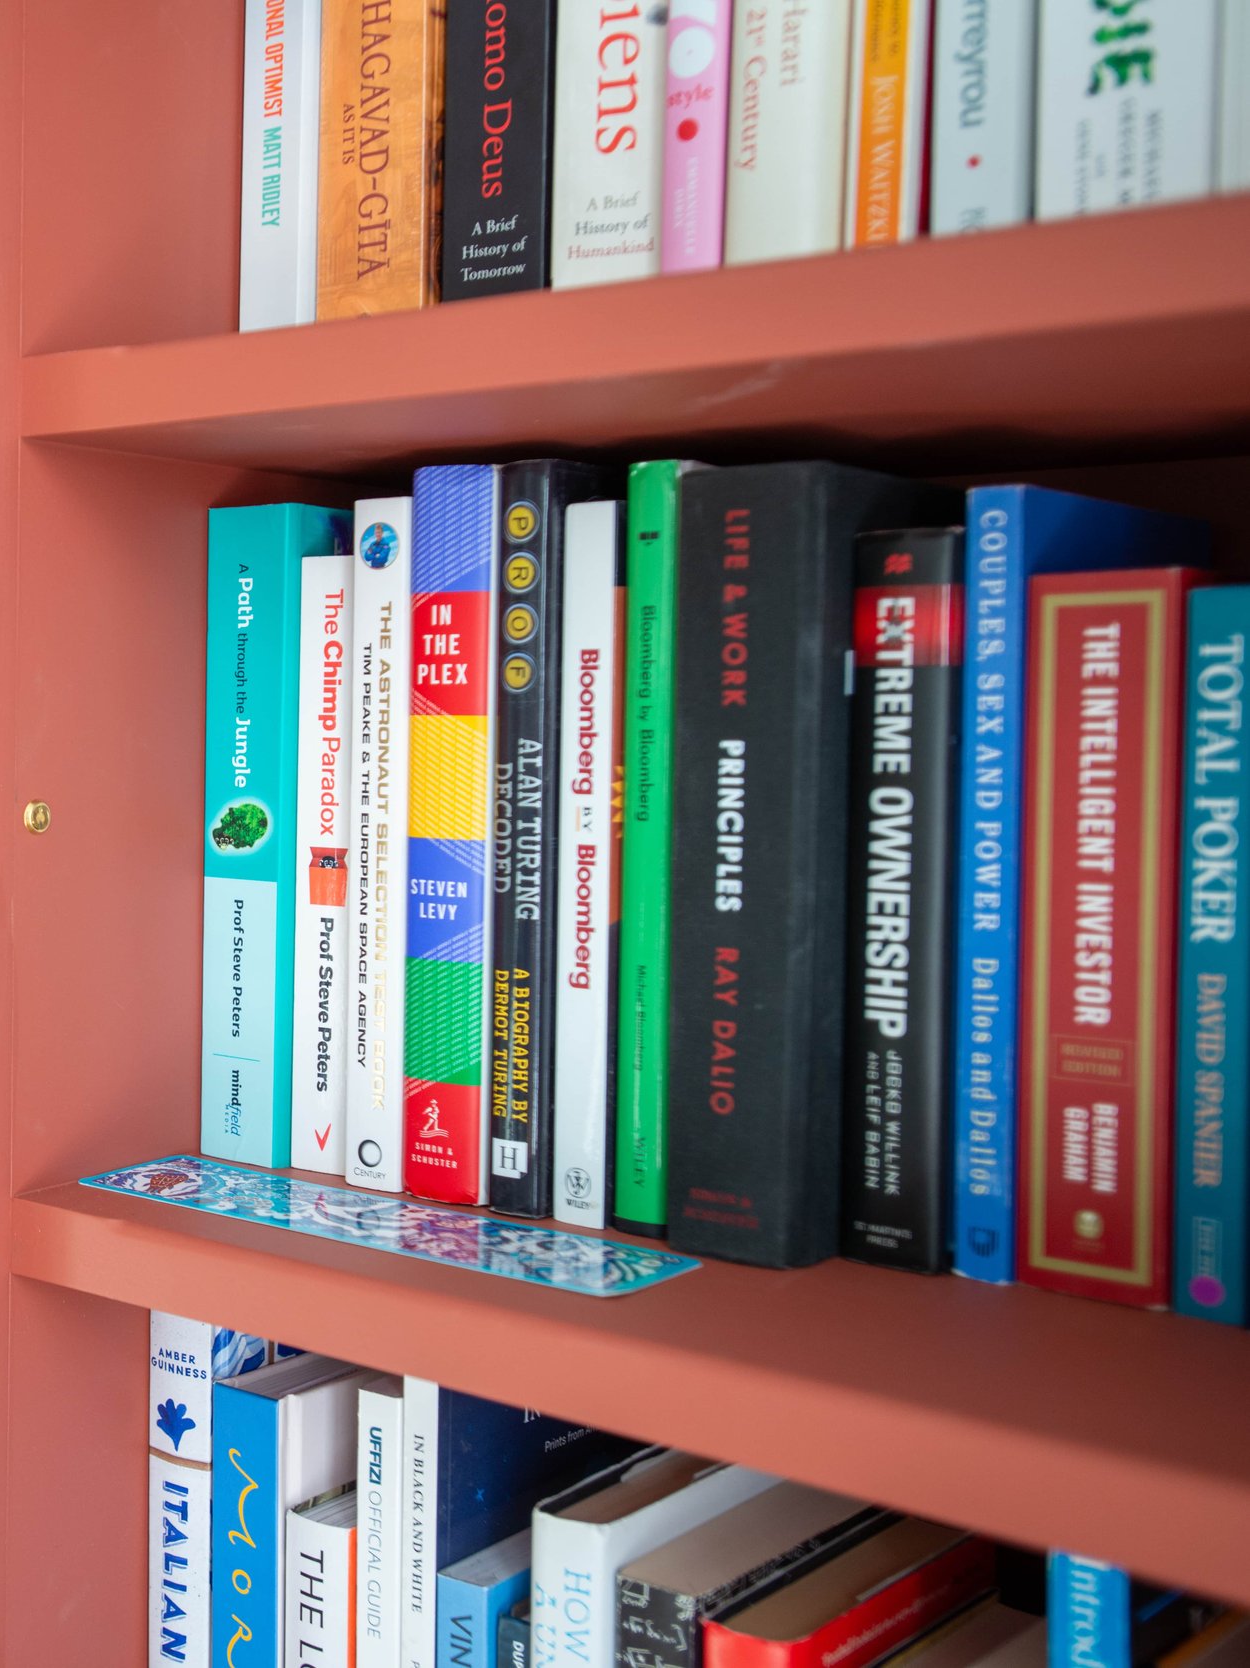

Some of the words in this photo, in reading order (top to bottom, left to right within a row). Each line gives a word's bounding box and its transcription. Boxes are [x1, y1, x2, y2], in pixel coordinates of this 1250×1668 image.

[483, 0, 509, 93] omo
[263, 43, 284, 119] OPTIMIST
[342, 103, 356, 125] AS
[342, 126, 356, 145] IT
[734, 55, 768, 171] Century
[263, 127, 283, 169] MATT
[342, 149, 355, 166] IS
[481, 99, 513, 200] Deus
[261, 175, 282, 227] RIDLEY
[471, 222, 482, 236] A
[486, 214, 519, 235] Brief
[574, 217, 628, 238] History
[632, 211, 653, 231] of
[587, 198, 598, 212] A
[602, 191, 640, 210] Brief
[460, 262, 527, 282] Tomorrow
[462, 241, 508, 260] History
[511, 236, 529, 252] of
[567, 238, 655, 261] Humankind
[238, 562, 250, 574] A
[724, 510, 751, 570] LIFE
[237, 576, 254, 629] Path
[325, 587, 345, 635] The
[431, 604, 453, 626] IN
[724, 584, 748, 603] &
[975, 509, 1009, 663] COUPLES,
[379, 601, 393, 650] THE
[422, 634, 462, 656] THE
[640, 605, 658, 699] Bloomberg
[1081, 622, 1121, 680] THE
[234, 632, 249, 687] through
[318, 639, 344, 731] Chimp
[363, 642, 373, 677] TIM
[416, 663, 470, 685] PLEX
[721, 613, 750, 706] WORK
[872, 596, 916, 775] EXTREME
[236, 691, 248, 714] the
[362, 682, 372, 753] PEAKE
[572, 648, 602, 796] Bloomberg
[639, 704, 653, 722] by
[976, 673, 1005, 735] SEX
[1194, 634, 1245, 786] TOTAL
[231, 716, 251, 788] Jungle
[361, 760, 372, 774] &
[376, 658, 392, 815] ASTRONAUT
[319, 736, 342, 836] Paradox
[361, 779, 371, 816] THE
[517, 737, 543, 808] ALAN
[636, 730, 656, 824] Bloomberg
[974, 743, 1004, 811] AND
[1076, 686, 1120, 873] INTELLIGENT
[494, 761, 514, 894] DECODED
[583, 806, 593, 833] BY
[715, 740, 748, 913] PRINCIPLES
[358, 821, 370, 917] EUROPEAN
[374, 822, 390, 962] SELECTION
[409, 878, 468, 899] STEVEN
[515, 815, 542, 922] TURING
[971, 821, 1003, 933] POWER
[1188, 796, 1240, 945] POKER
[231, 898, 245, 933] Prof
[317, 916, 336, 963] Prof
[419, 902, 458, 921] LEVY
[569, 844, 598, 991] Bloomberg
[863, 786, 915, 1039] OWNERSHIP
[231, 936, 245, 982] Steve
[358, 921, 369, 984] SPACE
[513, 967, 530, 979] A
[713, 947, 740, 1006] RAY
[1072, 883, 1114, 1028] INVESTOR
[231, 985, 244, 1038] Peters
[316, 966, 335, 1024] Steve
[494, 969, 510, 1037] DERMOT
[970, 957, 1001, 1044] Dallos
[1195, 972, 1229, 1066] DAVID
[315, 1026, 333, 1093] Peters
[356, 990, 368, 1069] AGENCY
[512, 986, 530, 1092] BIOGRAPHY
[493, 1048, 509, 1119] TURING
[711, 1020, 737, 1115] DALIO
[969, 1051, 999, 1099] and
[229, 1069, 243, 1137] mindfield
[512, 1098, 529, 1124] BY
[865, 1082, 881, 1125] LEIF
[1191, 1070, 1226, 1188] SPANIER
[410, 1152, 458, 1170] SCHUSTER
[414, 1141, 444, 1156] SIMON
[863, 1130, 881, 1190] BABIN
[883, 1120, 902, 1196] WILLINK
[967, 1110, 999, 1198] Dallos
[1062, 1106, 1089, 1183] GRAHAM
[1091, 1102, 1119, 1194] BENJAMIN
[151, 1356, 208, 1380] GUINNESS
[158, 1346, 196, 1365] AMBER
[369, 1425, 383, 1486] UFFIZI
[413, 1433, 425, 1454] IN
[544, 1436, 568, 1454] Prints
[412, 1457, 425, 1512] BLACK
[366, 1490, 383, 1575] OFFICIAL
[412, 1517, 425, 1554] AND
[160, 1479, 190, 1665] ITALIAN
[299, 1549, 324, 1630] THE
[411, 1557, 424, 1615] WHITE
[366, 1578, 383, 1640] GUIDE
[563, 1566, 594, 1663] HOW
